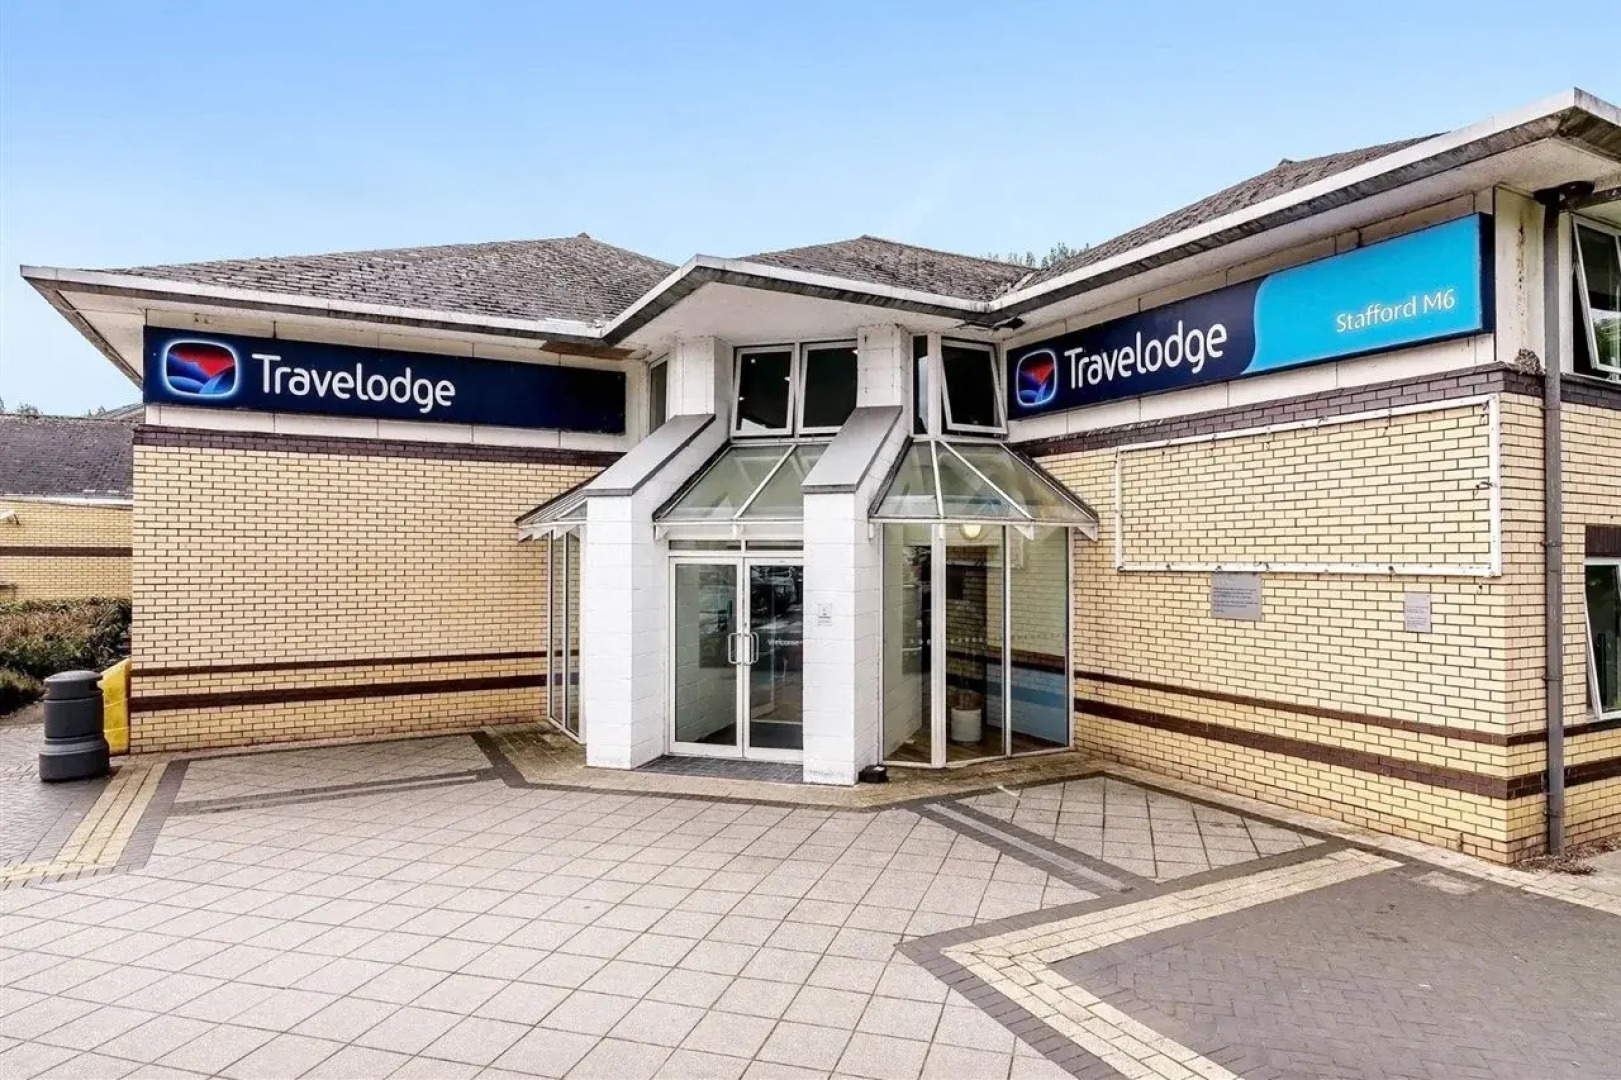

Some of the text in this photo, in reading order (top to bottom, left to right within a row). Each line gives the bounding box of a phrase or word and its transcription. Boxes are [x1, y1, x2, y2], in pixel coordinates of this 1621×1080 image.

[1336, 287, 1456, 333] Stafford M6
[251, 353, 456, 414] Travelodge
[1064, 320, 1227, 389] Travelodge
